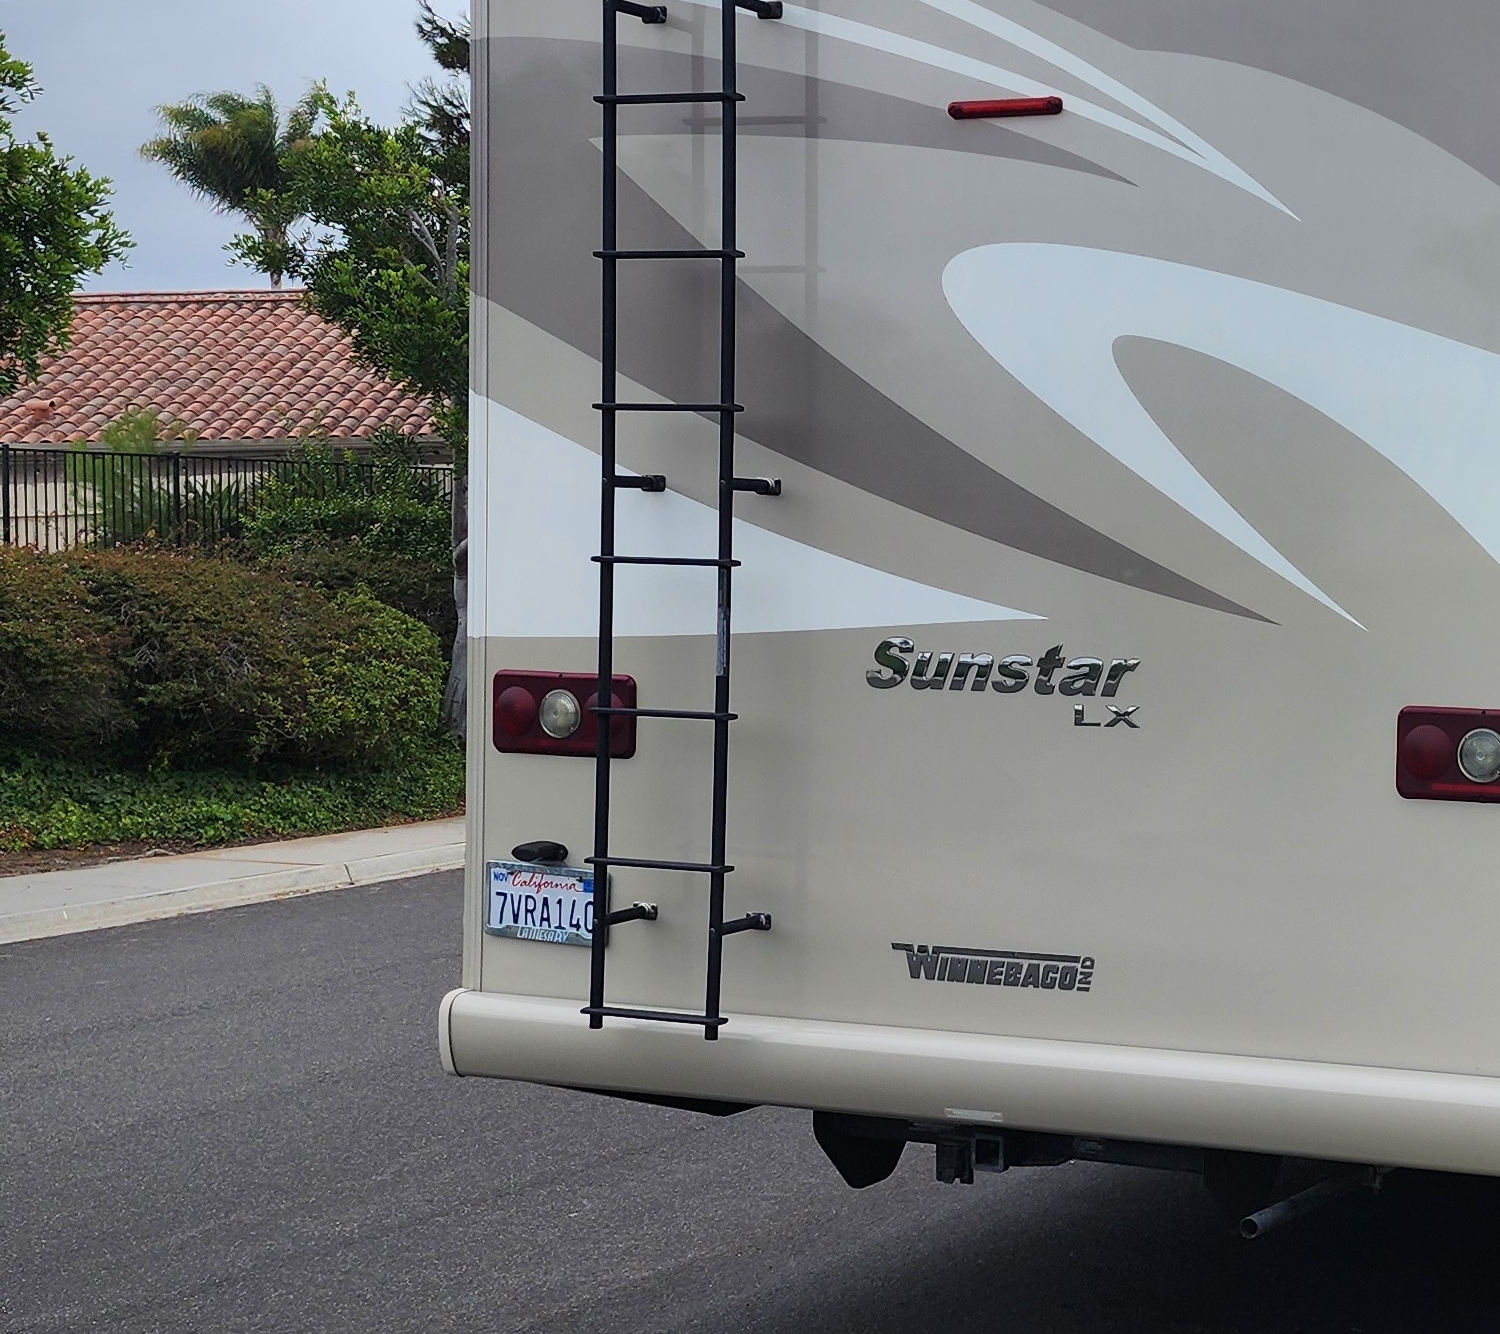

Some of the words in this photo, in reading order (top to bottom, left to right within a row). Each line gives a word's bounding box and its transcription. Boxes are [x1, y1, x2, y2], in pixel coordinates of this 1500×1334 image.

[865, 635, 1142, 698] Sunstar
[1073, 703, 1141, 729] LX
[493, 871, 509, 882] NOV
[511, 870, 584, 895] California
[896, 945, 1080, 992] WINNEBAGO
[1076, 956, 1096, 993] IND
